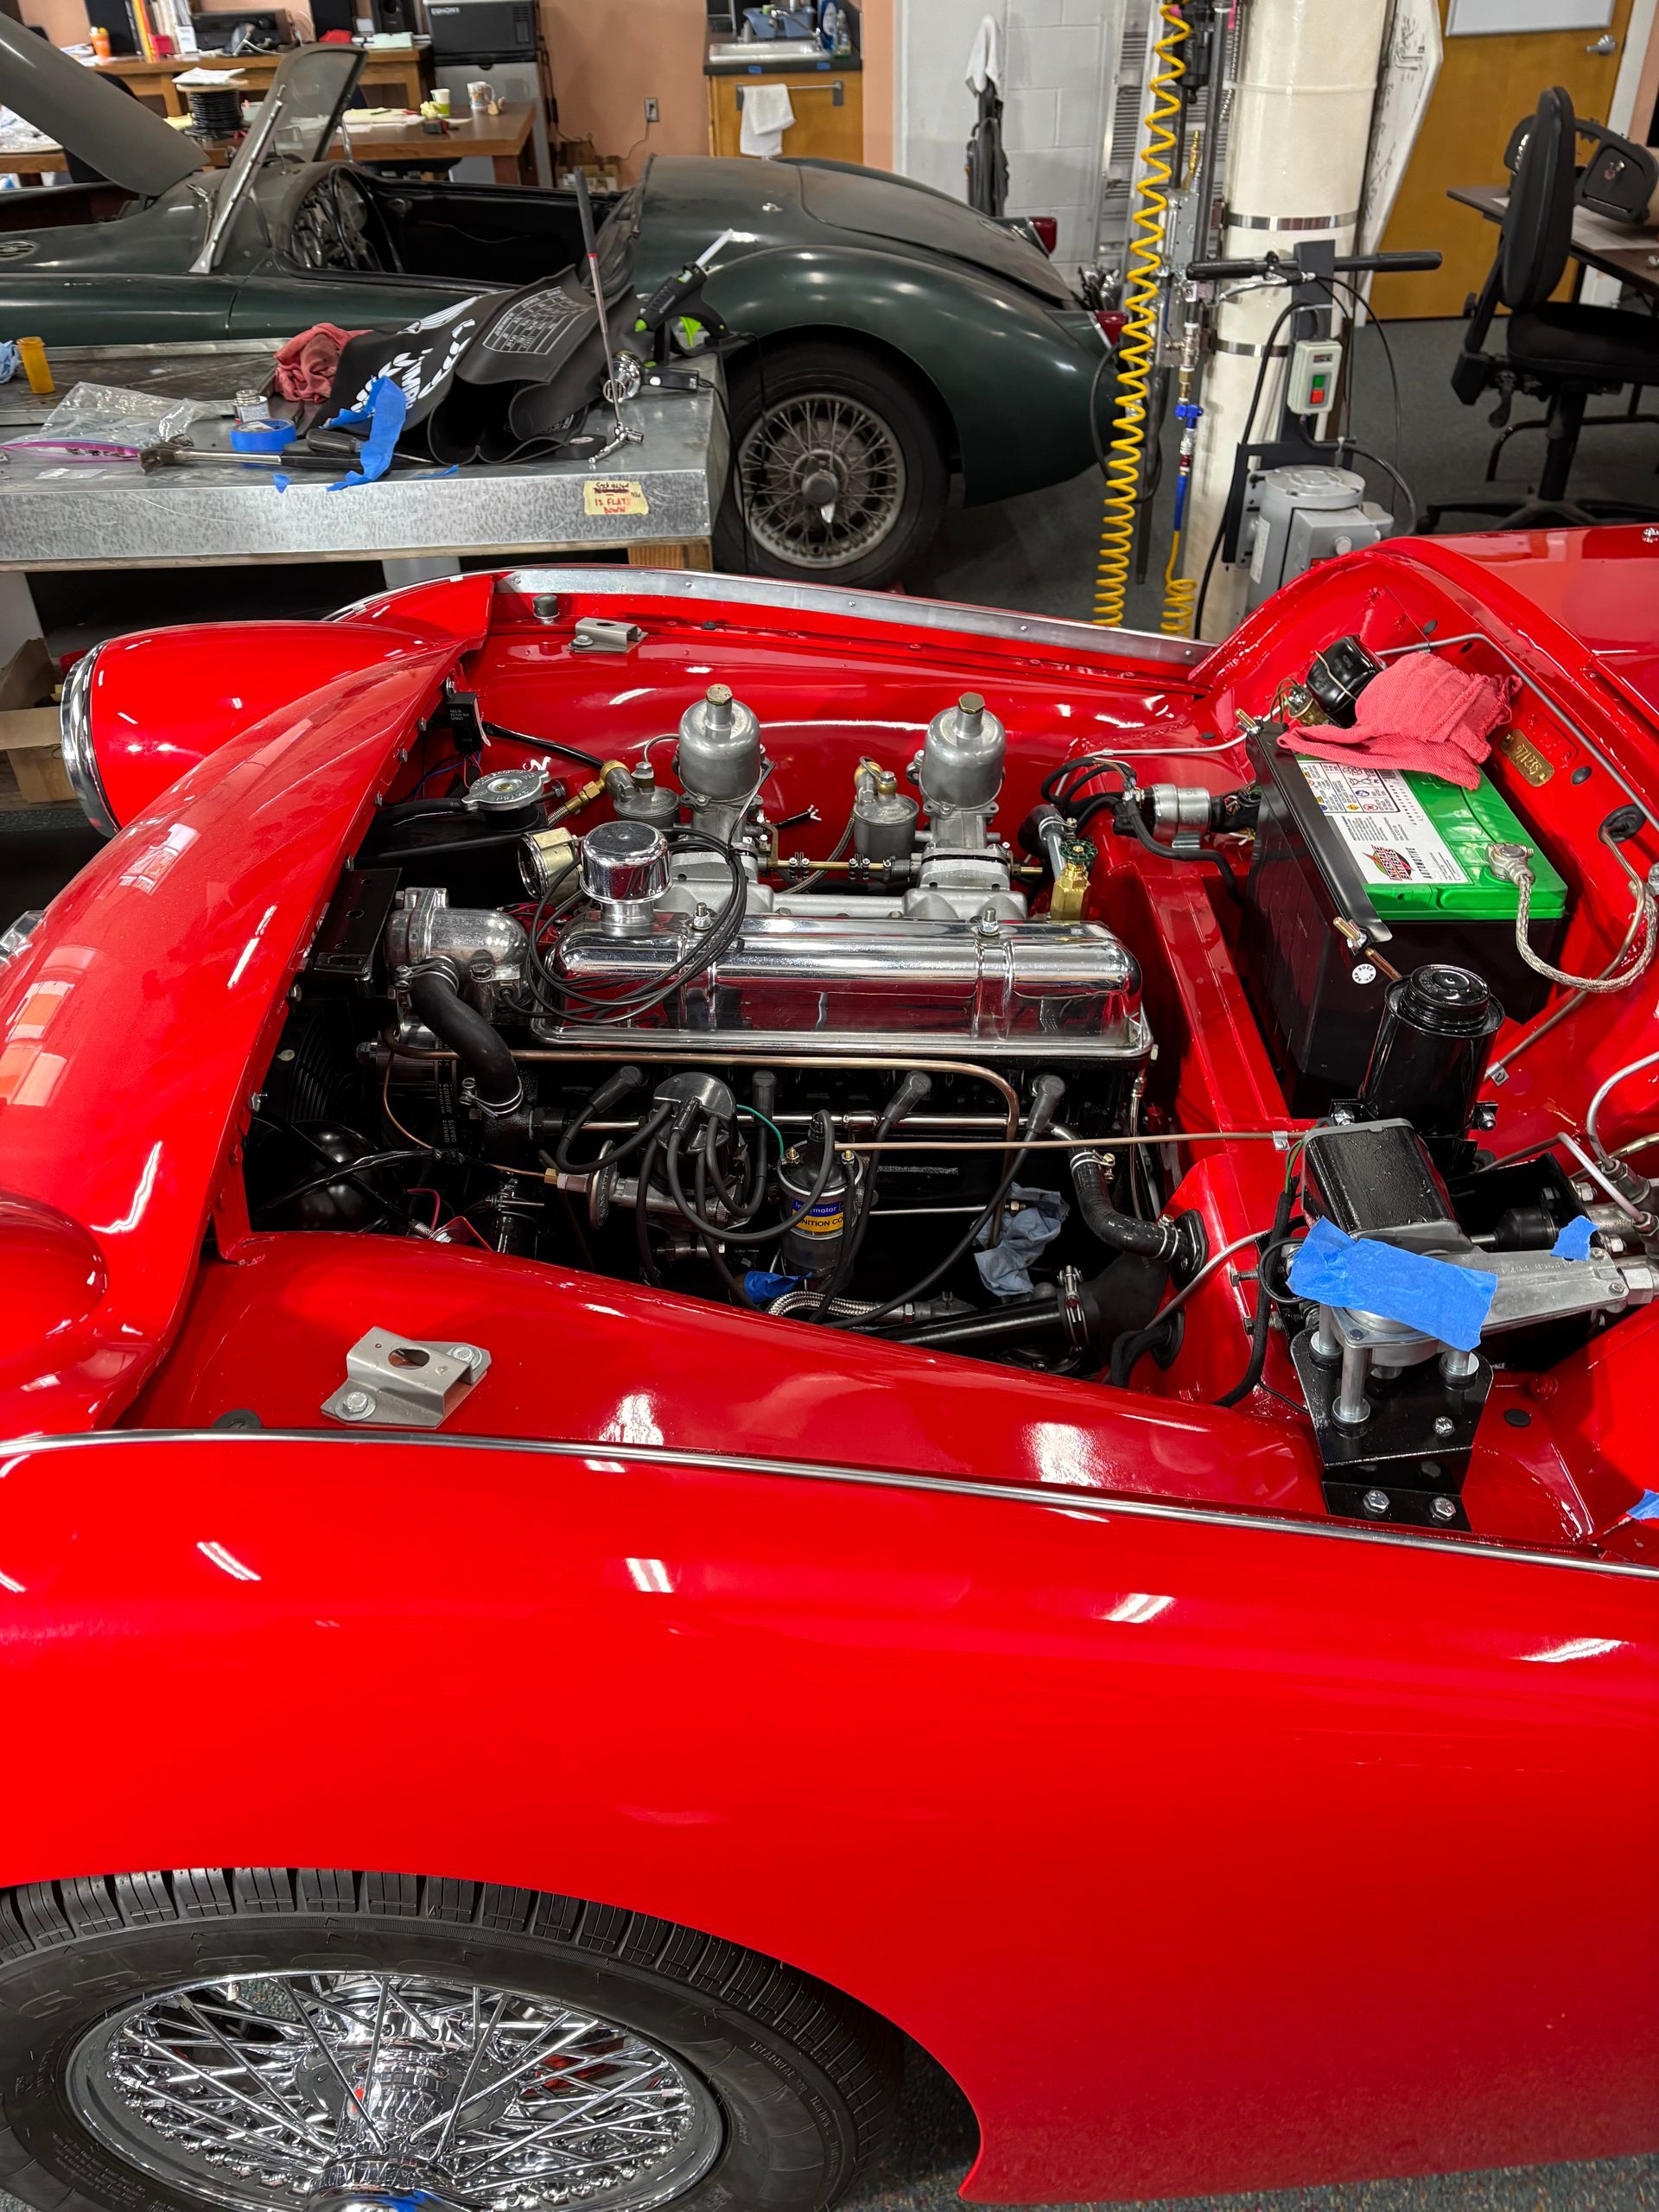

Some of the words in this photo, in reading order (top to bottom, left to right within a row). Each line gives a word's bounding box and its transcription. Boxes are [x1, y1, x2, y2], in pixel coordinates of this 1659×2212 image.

[1374, 846, 1400, 880] INTERSTATE
[1384, 849, 1411, 880] BATTERIES
[1405, 847, 1433, 880] AUTOMOTIVE
